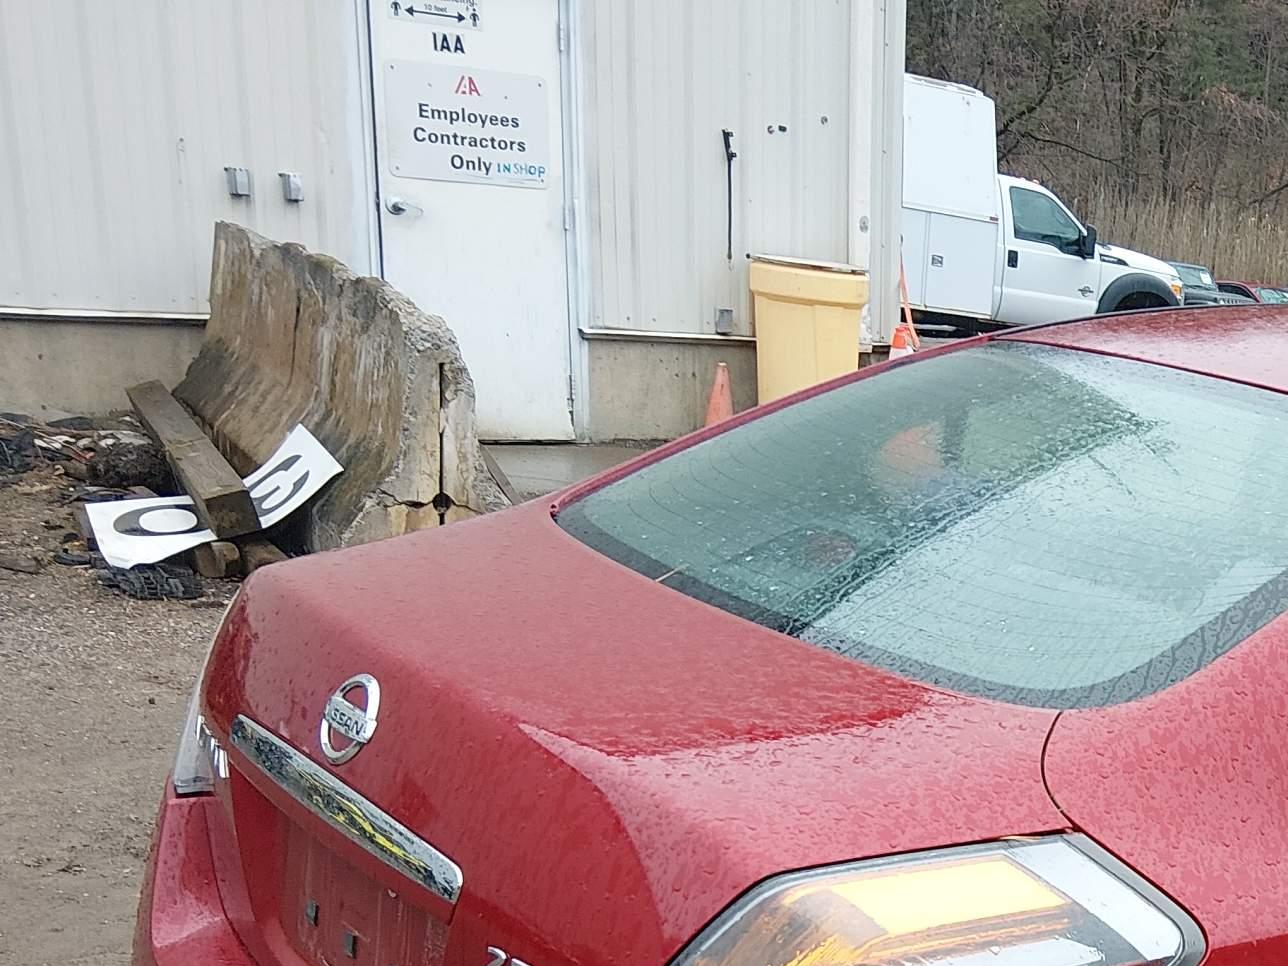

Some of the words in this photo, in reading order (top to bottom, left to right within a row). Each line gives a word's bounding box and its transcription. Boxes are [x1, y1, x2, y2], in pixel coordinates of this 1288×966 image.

[432, 32, 466, 55] IAA
[418, 103, 520, 129] Employees
[413, 127, 527, 152] Contractors
[450, 154, 493, 176] Only
[497, 163, 511, 173] IN
[513, 163, 546, 178] SHOP
